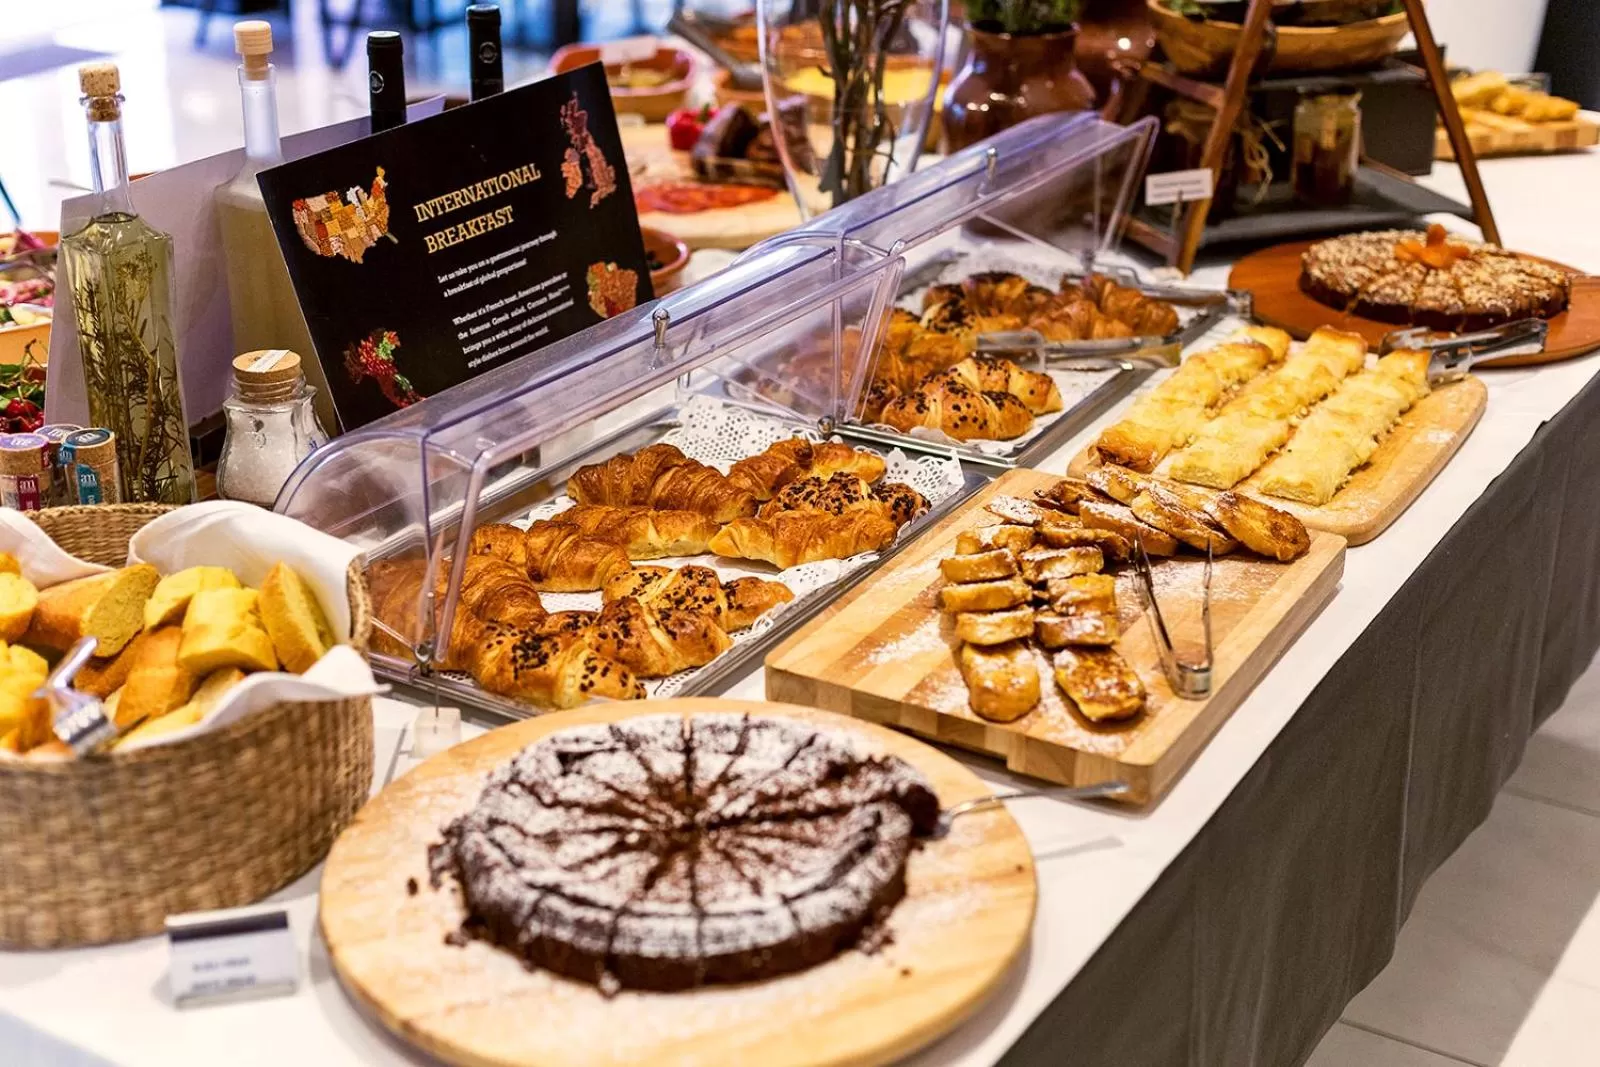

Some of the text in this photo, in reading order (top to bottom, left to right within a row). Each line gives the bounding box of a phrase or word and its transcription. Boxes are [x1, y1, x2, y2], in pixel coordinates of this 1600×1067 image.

[413, 163, 541, 223] INTERNATIONAL
[424, 205, 514, 254] BREAKFAST
[438, 275, 448, 283] Let
[485, 300, 504, 312] French
[492, 314, 509, 325] Greek
